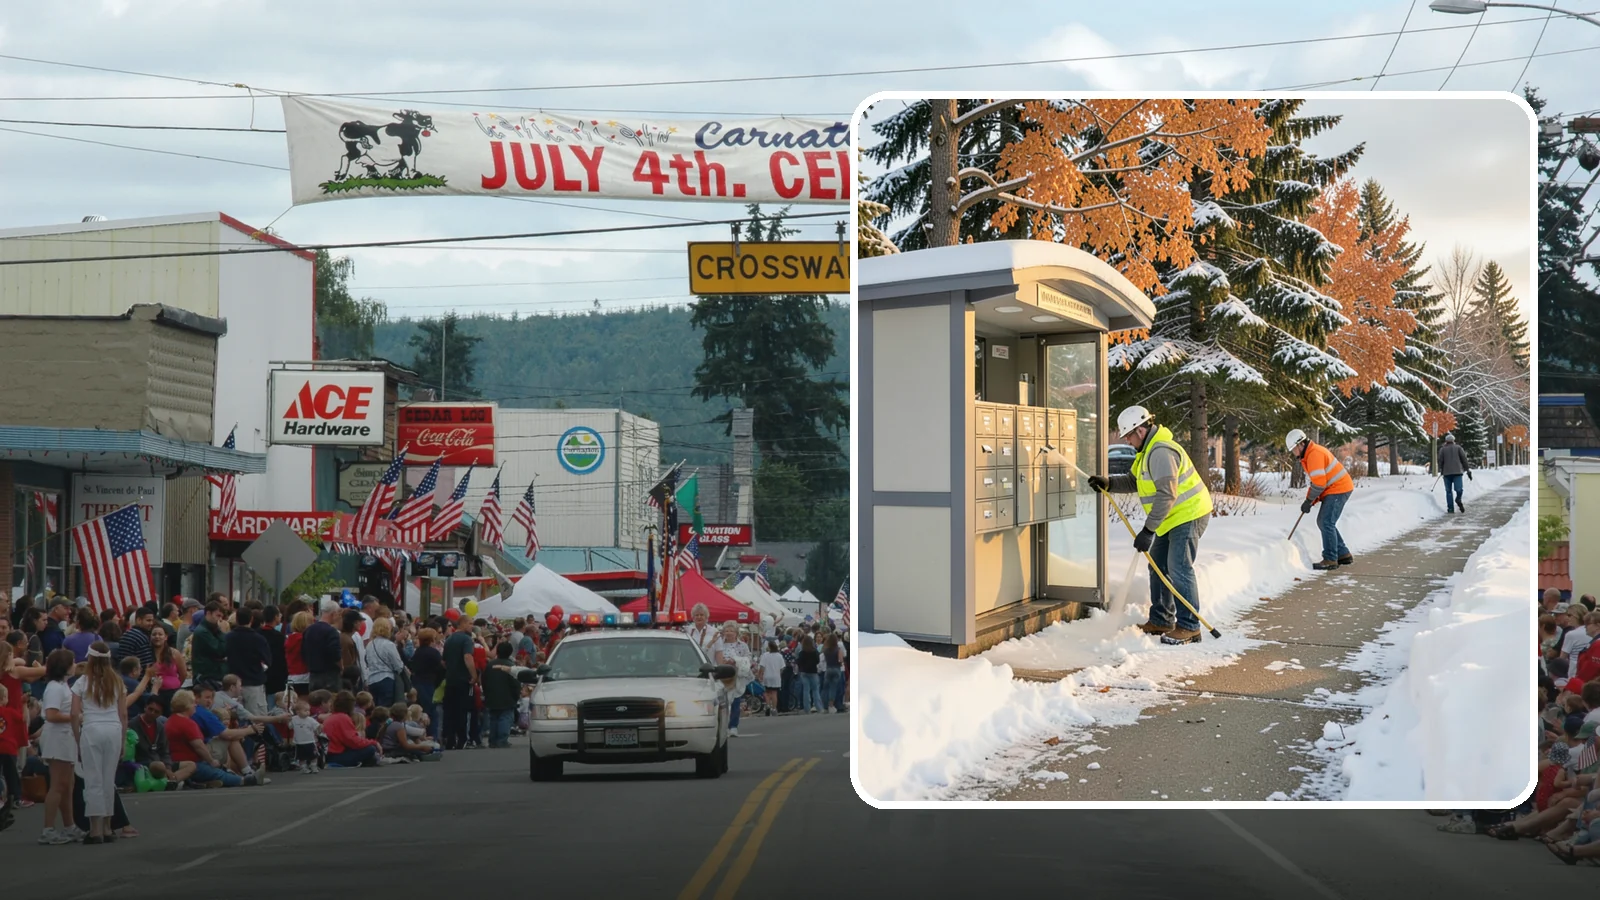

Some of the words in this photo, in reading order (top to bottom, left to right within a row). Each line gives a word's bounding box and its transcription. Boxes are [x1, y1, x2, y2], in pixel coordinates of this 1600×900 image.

[481, 141, 605, 193] JULY
[632, 150, 746, 198] 4th.
[697, 254, 850, 280] CROSSWA
[283, 380, 373, 419] ACE
[405, 409, 452, 422] CEDAR
[461, 409, 485, 421] LOG
[283, 421, 371, 436] Hardware
[416, 428, 477, 447] Coca-Cola
[353, 467, 385, 480] Simpl
[95, 485, 124, 494] Vincent
[126, 486, 135, 494] de
[137, 486, 155, 495] Paul
[81, 503, 153, 522] THRT
[688, 526, 741, 535] CRNATION
[699, 535, 730, 543] GLASS
